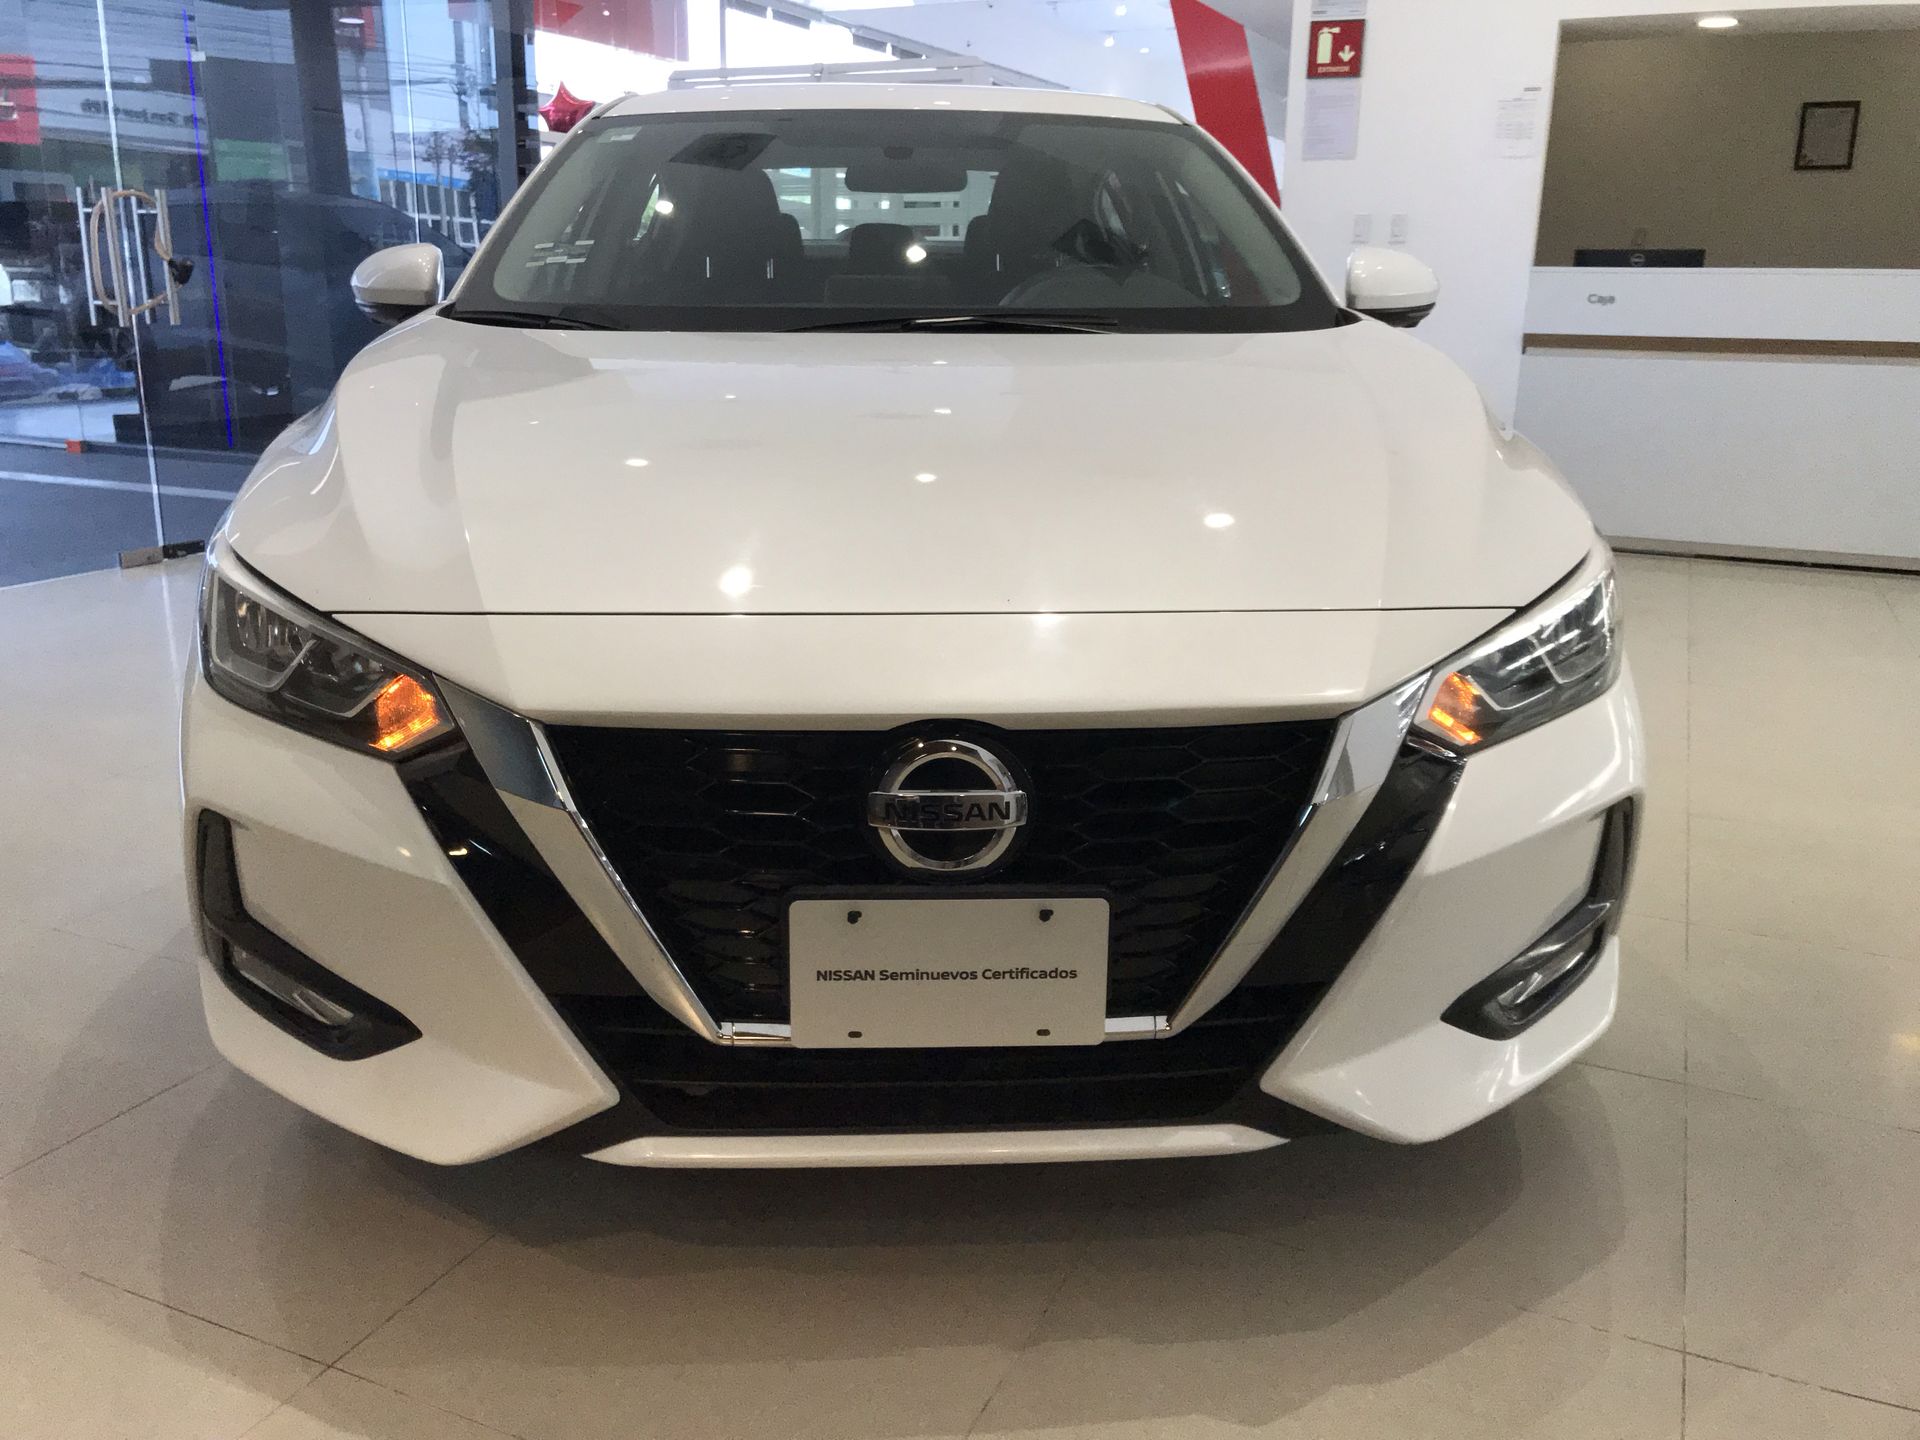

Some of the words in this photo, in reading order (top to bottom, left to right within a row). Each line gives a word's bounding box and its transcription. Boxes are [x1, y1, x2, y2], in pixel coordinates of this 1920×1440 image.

[883, 800, 1011, 823] NISSAN
[816, 970, 875, 981] NISSAN
[879, 969, 978, 981] Seminuevos
[981, 967, 1078, 980] Certificados
